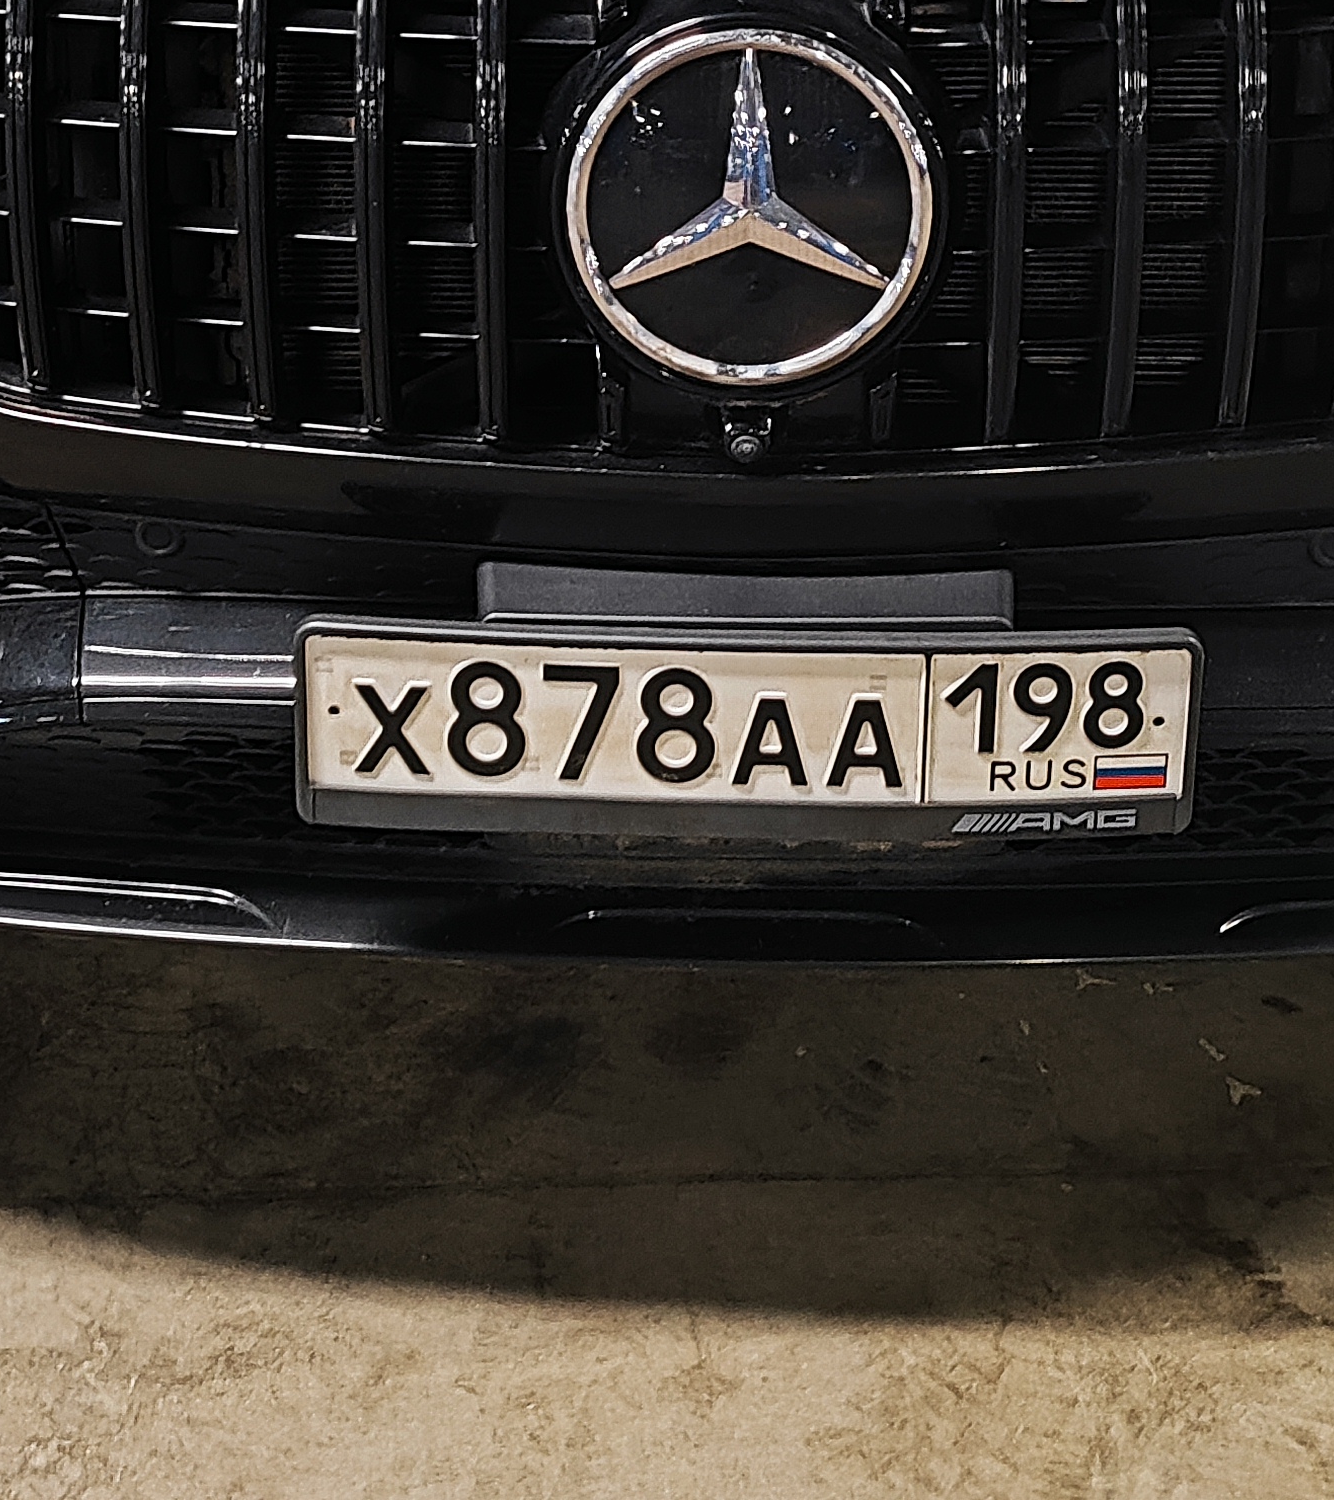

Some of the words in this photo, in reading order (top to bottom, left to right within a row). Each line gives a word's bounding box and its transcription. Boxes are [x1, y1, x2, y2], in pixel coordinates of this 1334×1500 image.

[944, 660, 1144, 755] 198
[989, 758, 1087, 792] RUS
[1008, 808, 1137, 833] AMG
